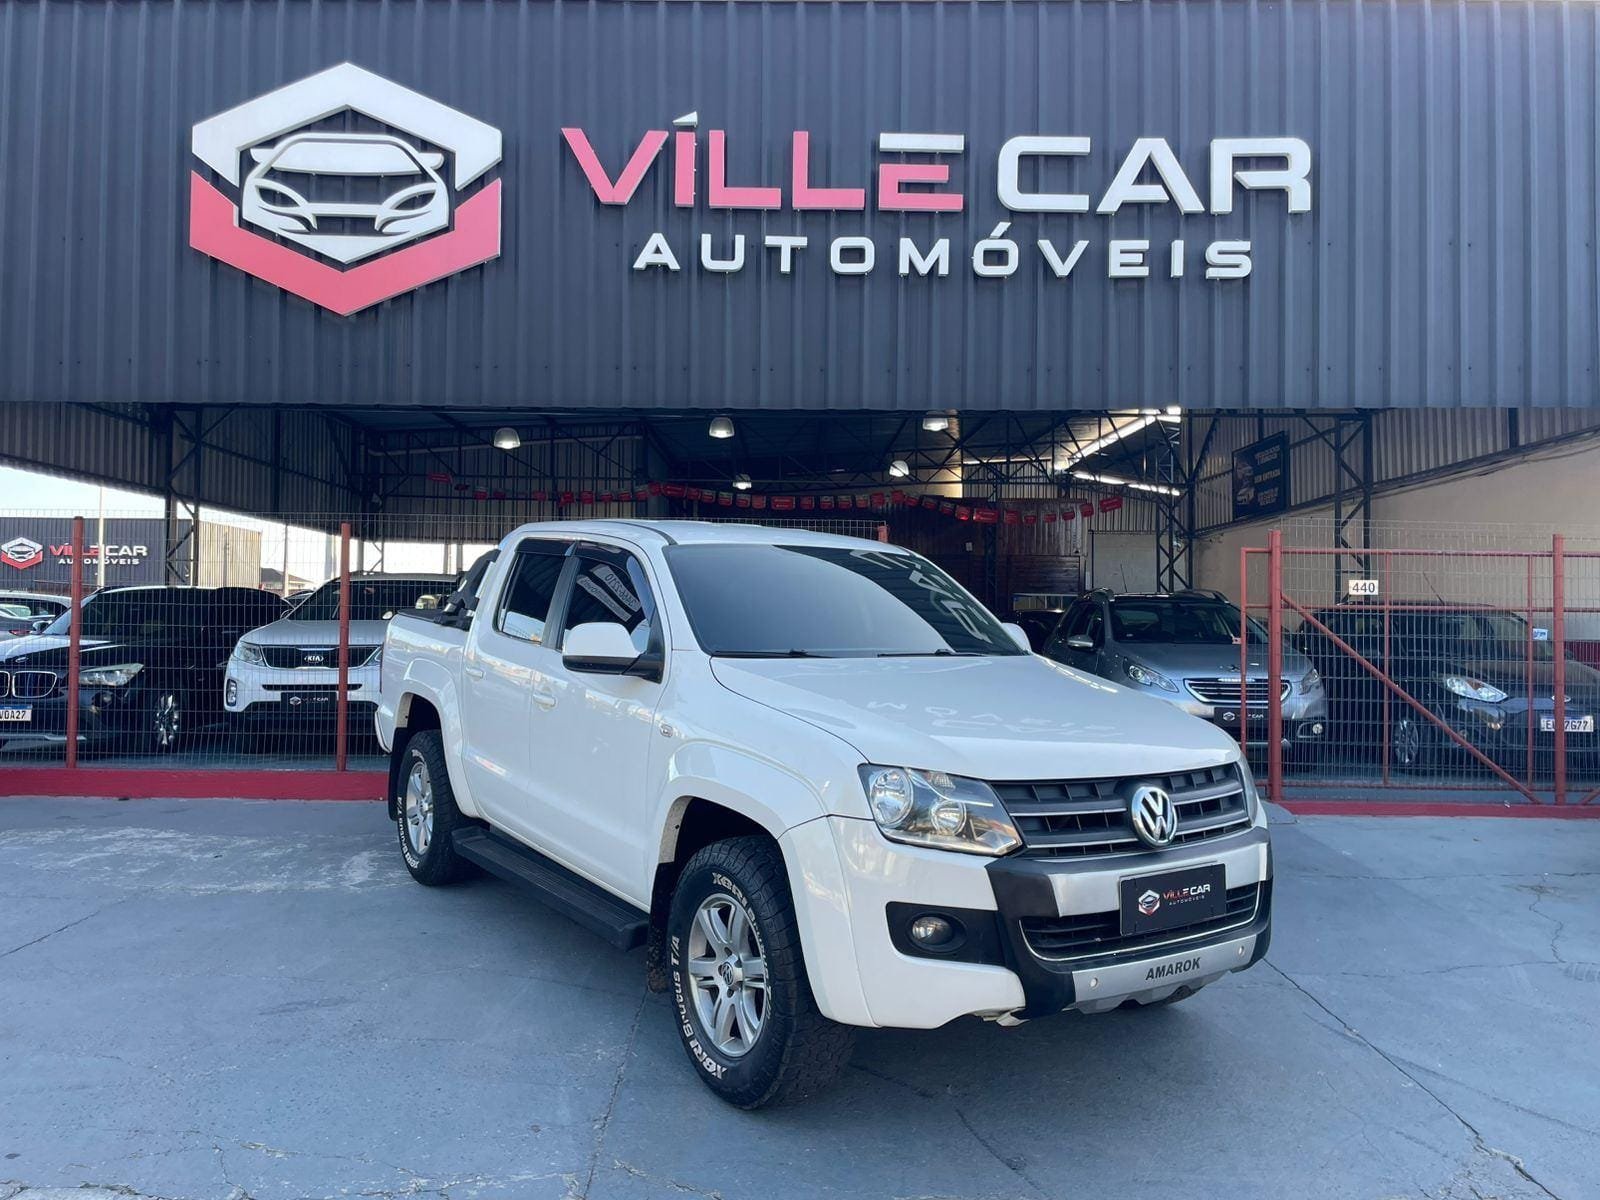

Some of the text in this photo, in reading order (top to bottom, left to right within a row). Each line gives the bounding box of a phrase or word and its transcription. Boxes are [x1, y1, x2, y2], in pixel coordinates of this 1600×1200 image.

[561, 111, 1312, 216] VÍLLE CAR
[632, 221, 1253, 280] AUTOMÓVEIS
[105, 545, 148, 557] CAR
[58, 556, 140, 565] AUOMÓVEIS
[1352, 582, 1376, 593] 440
[1190, 883, 1211, 896] CAR
[1145, 957, 1202, 981] AMAROK
